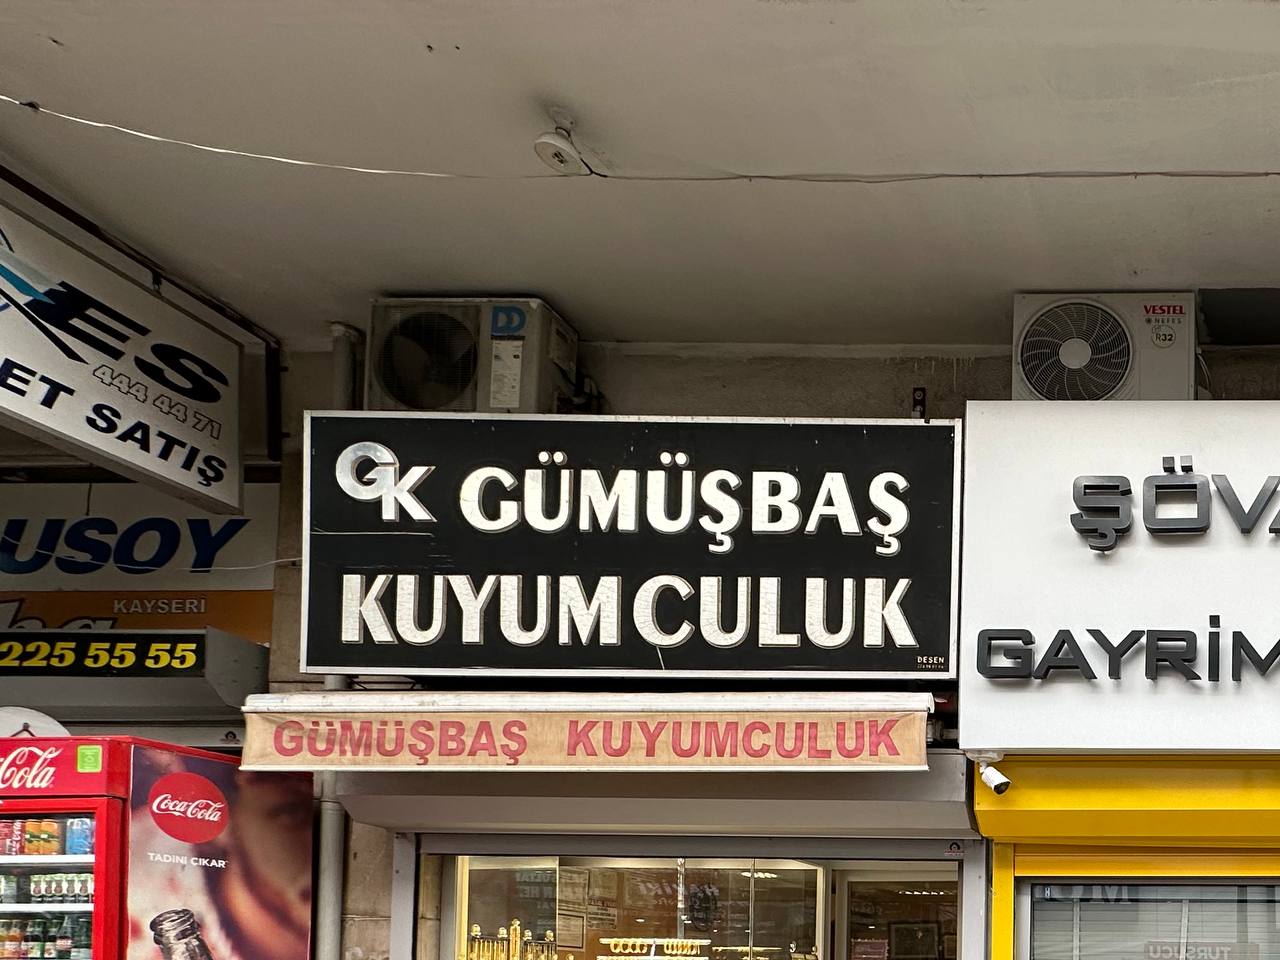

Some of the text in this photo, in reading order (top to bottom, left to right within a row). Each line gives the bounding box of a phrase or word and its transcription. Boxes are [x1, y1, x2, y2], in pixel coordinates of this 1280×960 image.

[1144, 304, 1186, 315] VESTEL
[1155, 333, 1174, 342] R32
[93, 364, 222, 440] 444 44 71
[85, 402, 228, 488] SATIŞ
[459, 449, 912, 558] GÜMÜŞBAŞ
[113, 596, 207, 614] KAYSERİ
[340, 573, 920, 649] KUYUMCULUK
[0, 641, 197, 670] 225 55 55
[916, 655, 945, 664] DESEN
[272, 717, 901, 766] GÜMÜŞBAŞ KUYUMCULUK
[152, 793, 226, 822] Coca-Cola
